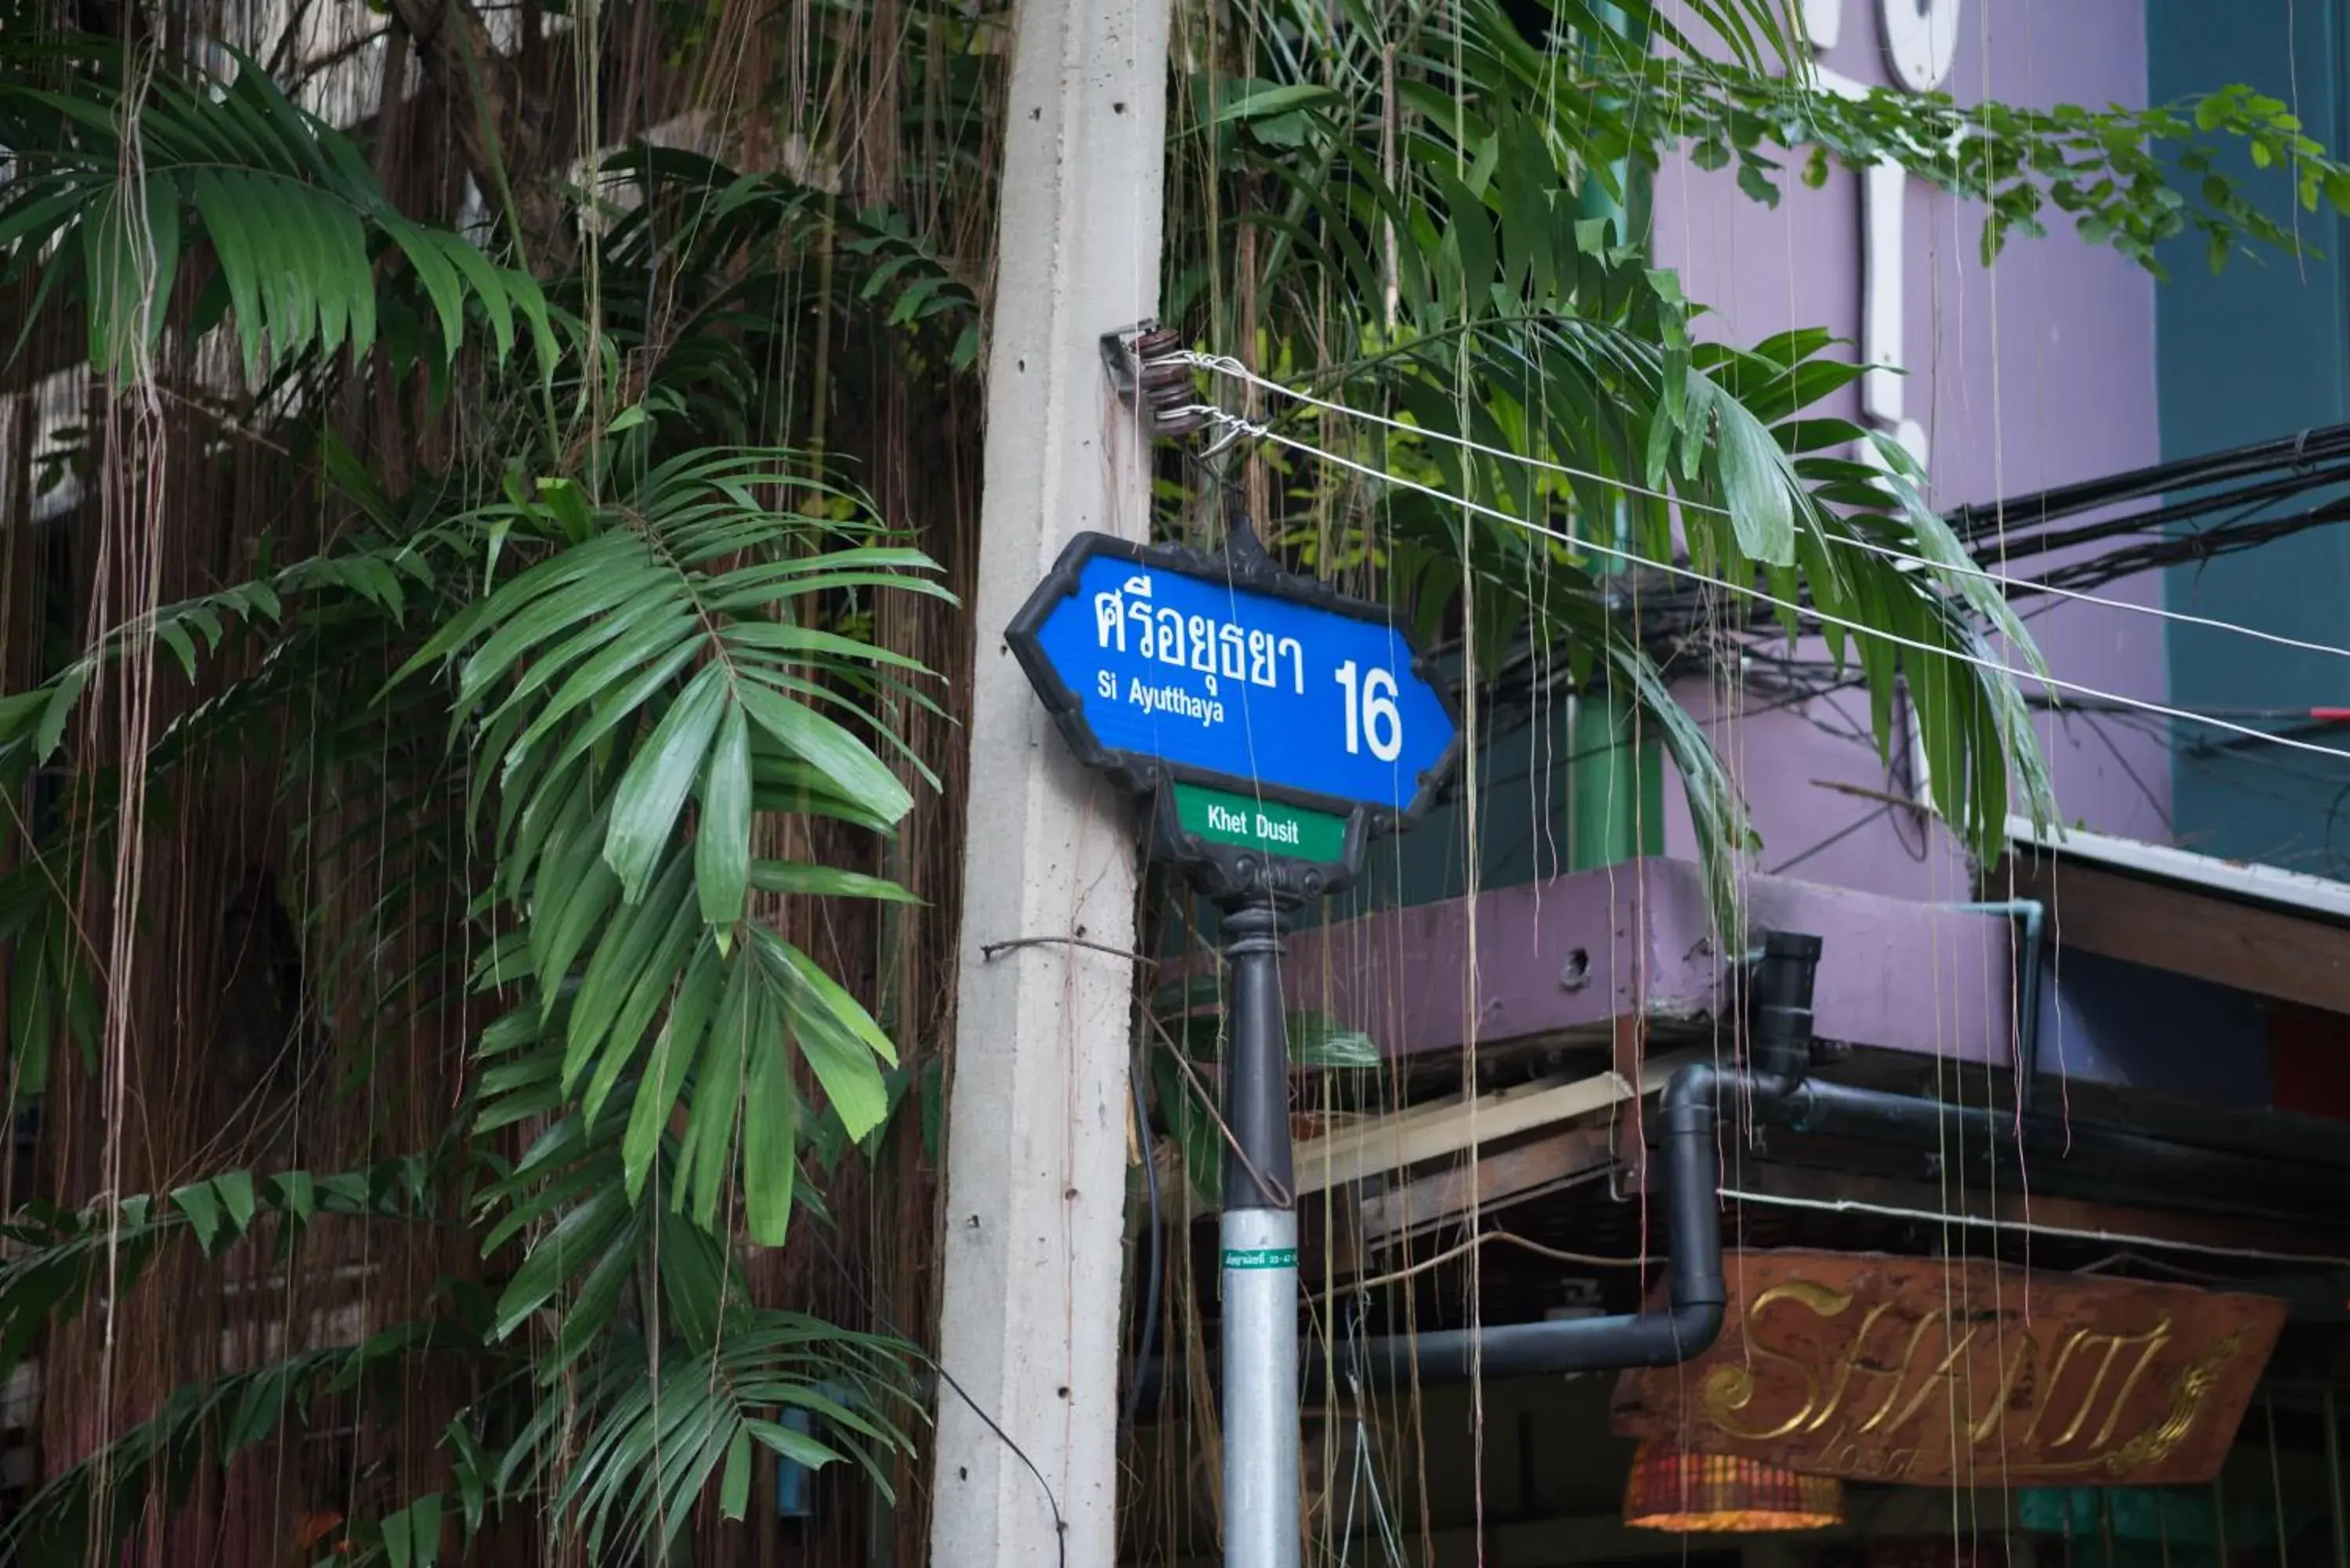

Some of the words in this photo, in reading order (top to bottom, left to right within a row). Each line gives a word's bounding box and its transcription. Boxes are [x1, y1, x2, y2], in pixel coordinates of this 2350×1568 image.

[1094, 576, 1303, 696] ศรีอยุธยา
[1097, 670, 1117, 699] Si
[1129, 677, 1224, 728] Ayutthaya
[1335, 659, 1402, 762] 16
[1208, 804, 1248, 834] Khet
[1256, 814, 1299, 844] Dusit
[1705, 1281, 2175, 1448] SHANTI
